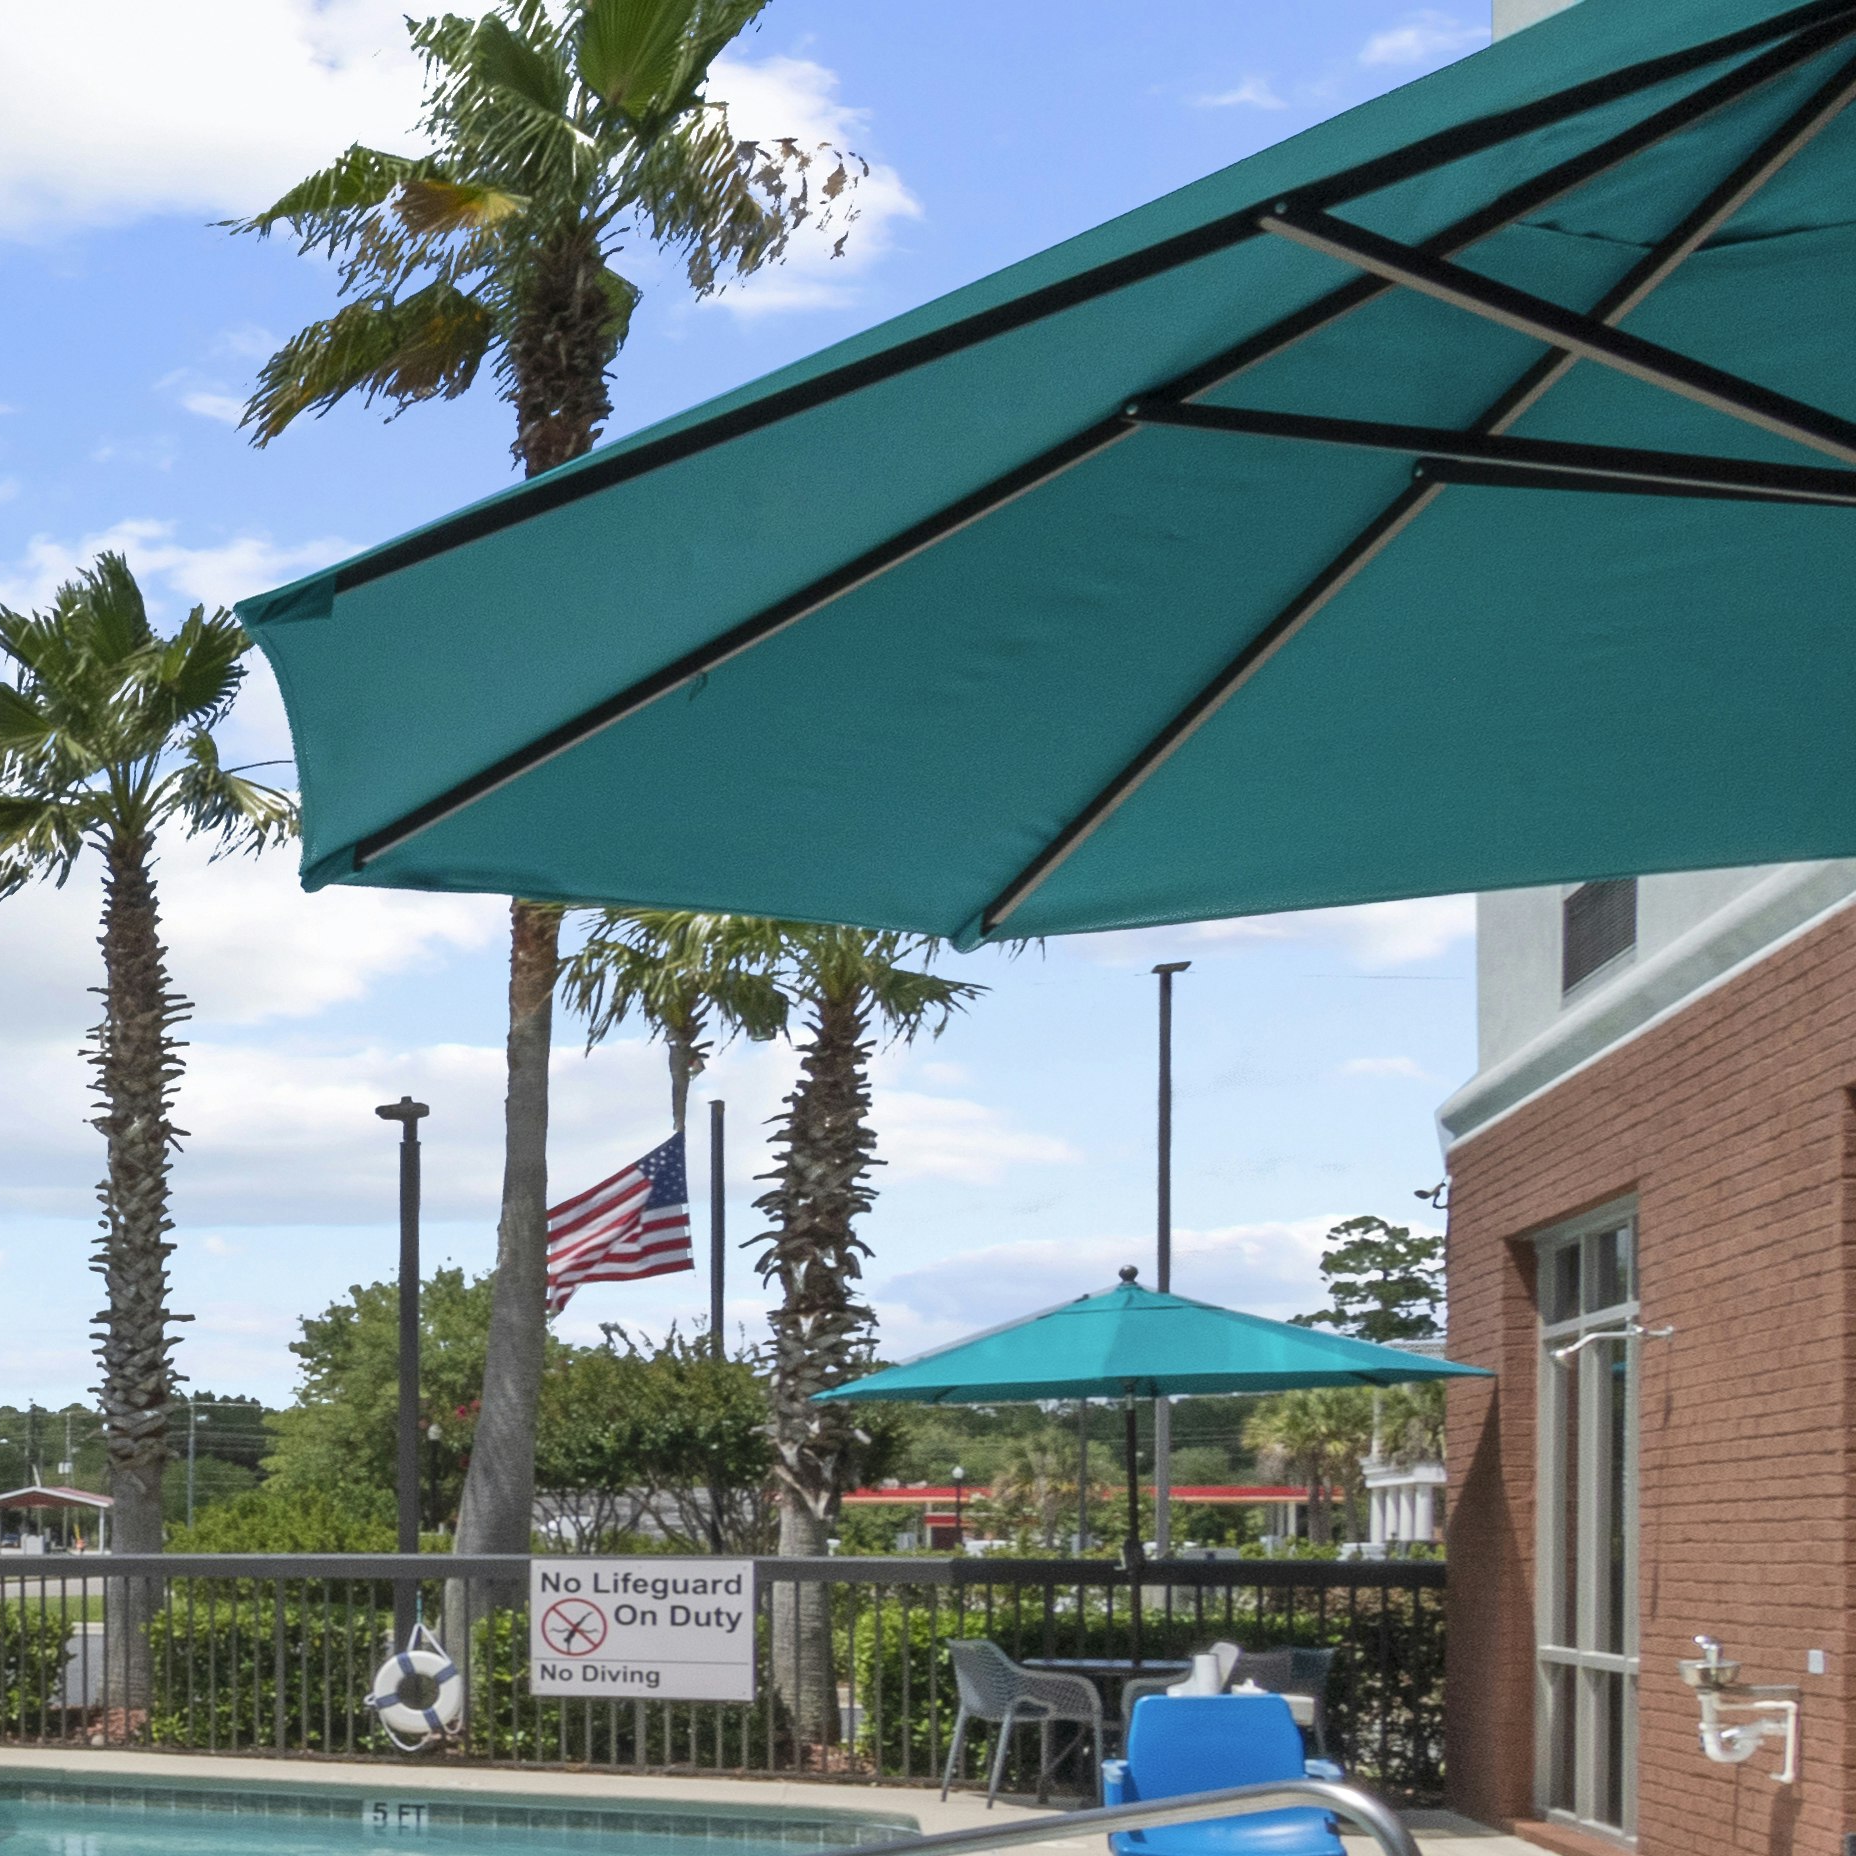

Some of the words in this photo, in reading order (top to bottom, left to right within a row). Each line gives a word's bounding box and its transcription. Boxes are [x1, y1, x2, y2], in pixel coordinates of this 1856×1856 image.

[541, 1572, 582, 1593] No
[593, 1572, 742, 1600] Lifeguard
[614, 1604, 658, 1626] On
[670, 1605, 742, 1633] Duty
[540, 1664, 573, 1681] No
[582, 1665, 660, 1688] Diving
[373, 1802, 387, 1821] 5
[398, 1804, 426, 1823] FT
